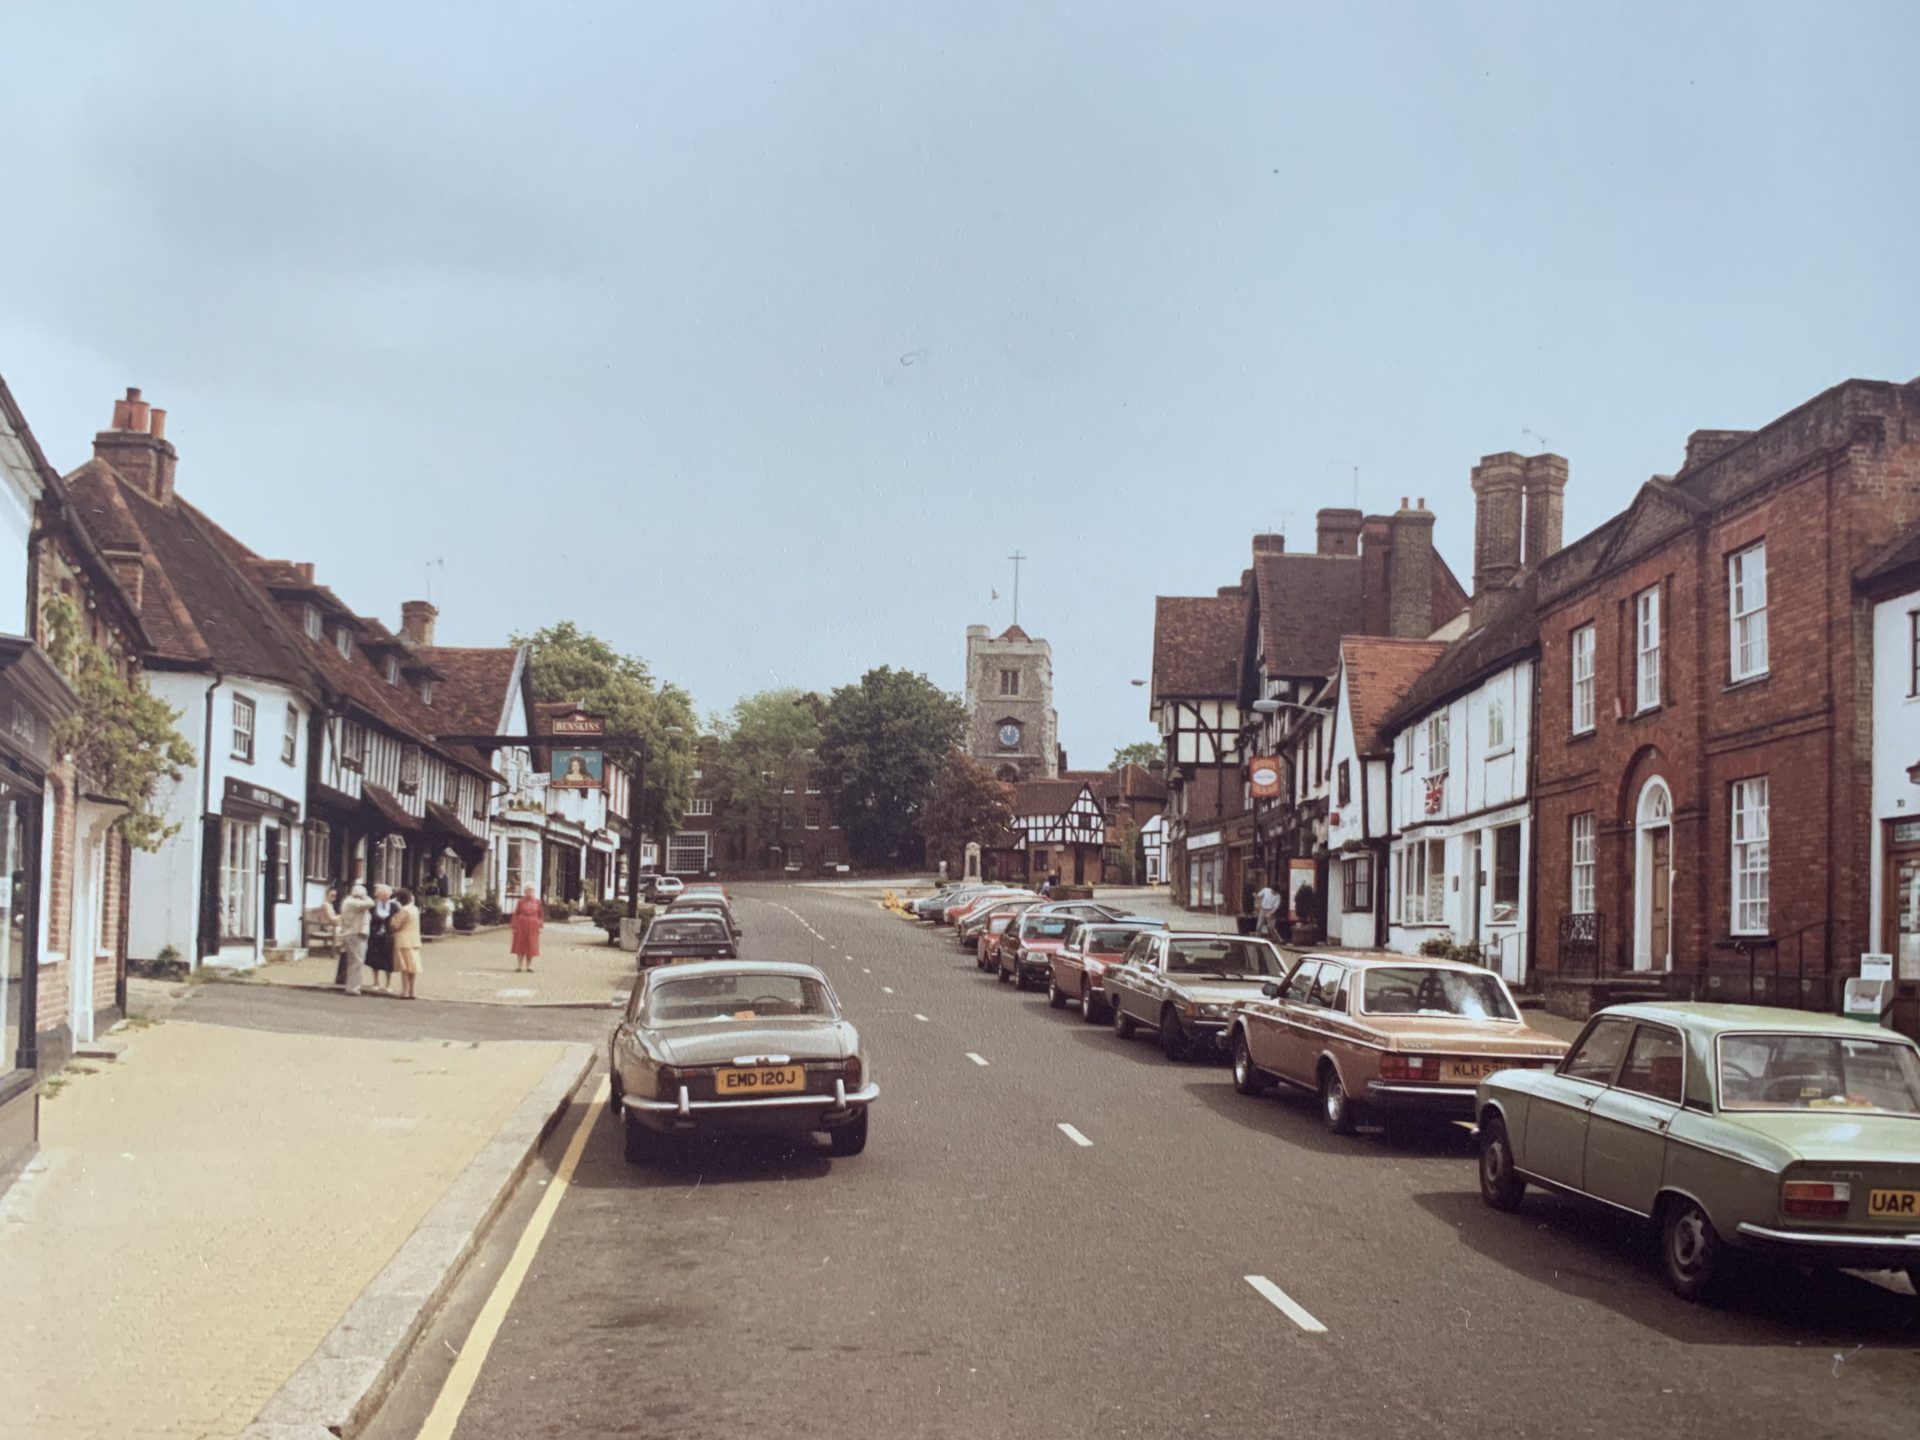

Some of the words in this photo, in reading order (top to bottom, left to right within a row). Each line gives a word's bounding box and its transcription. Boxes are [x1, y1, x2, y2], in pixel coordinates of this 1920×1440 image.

[556, 721, 600, 731] BENSKINS
[1453, 1063, 1480, 1076] KLH
[726, 1073, 758, 1088] EMD
[761, 1070, 796, 1086] 120J
[1872, 1193, 1916, 1213] UAR
